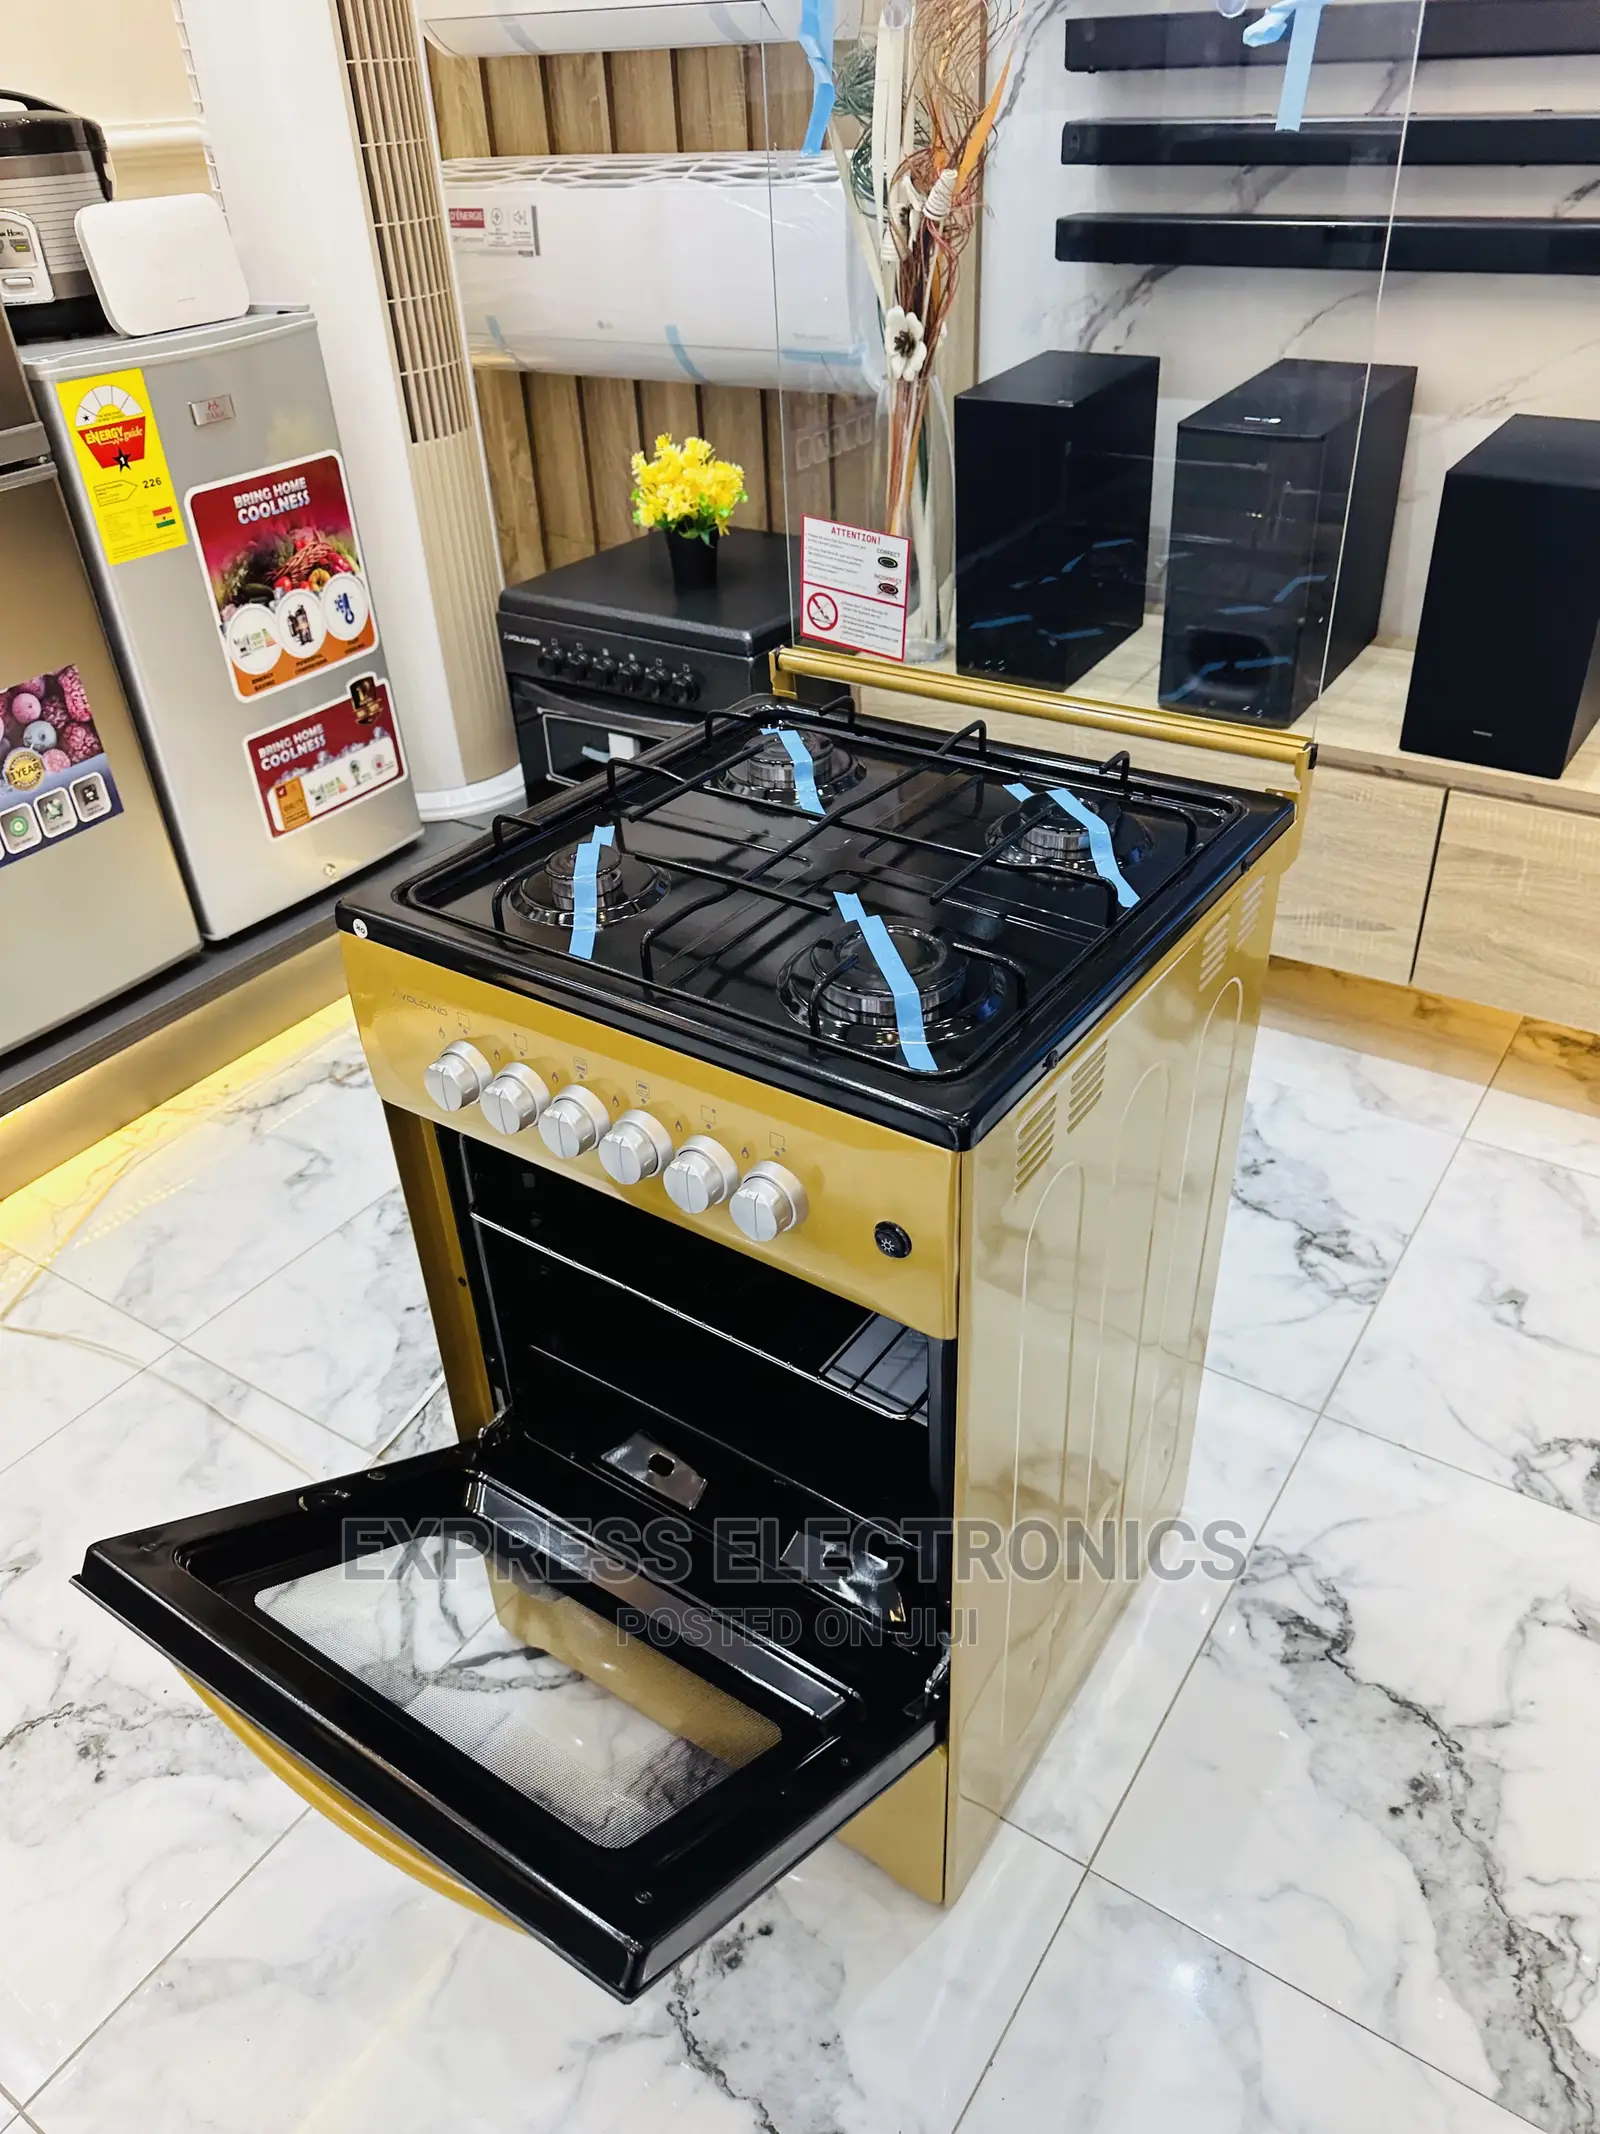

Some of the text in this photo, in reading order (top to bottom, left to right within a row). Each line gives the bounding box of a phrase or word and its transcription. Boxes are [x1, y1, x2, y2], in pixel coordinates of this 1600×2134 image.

[85, 426, 143, 445] ENERGY guide
[120, 456, 126, 465] 1
[142, 477, 162, 489] 226
[233, 476, 308, 510] BRING HOME
[237, 489, 311, 525] COOLNESS
[831, 526, 881, 546] ATTENTION!
[876, 547, 901, 558] CORRECT
[258, 723, 324, 760] BRING HOME
[260, 733, 327, 771] COOLNESS
[15, 762, 40, 778] YEAR
